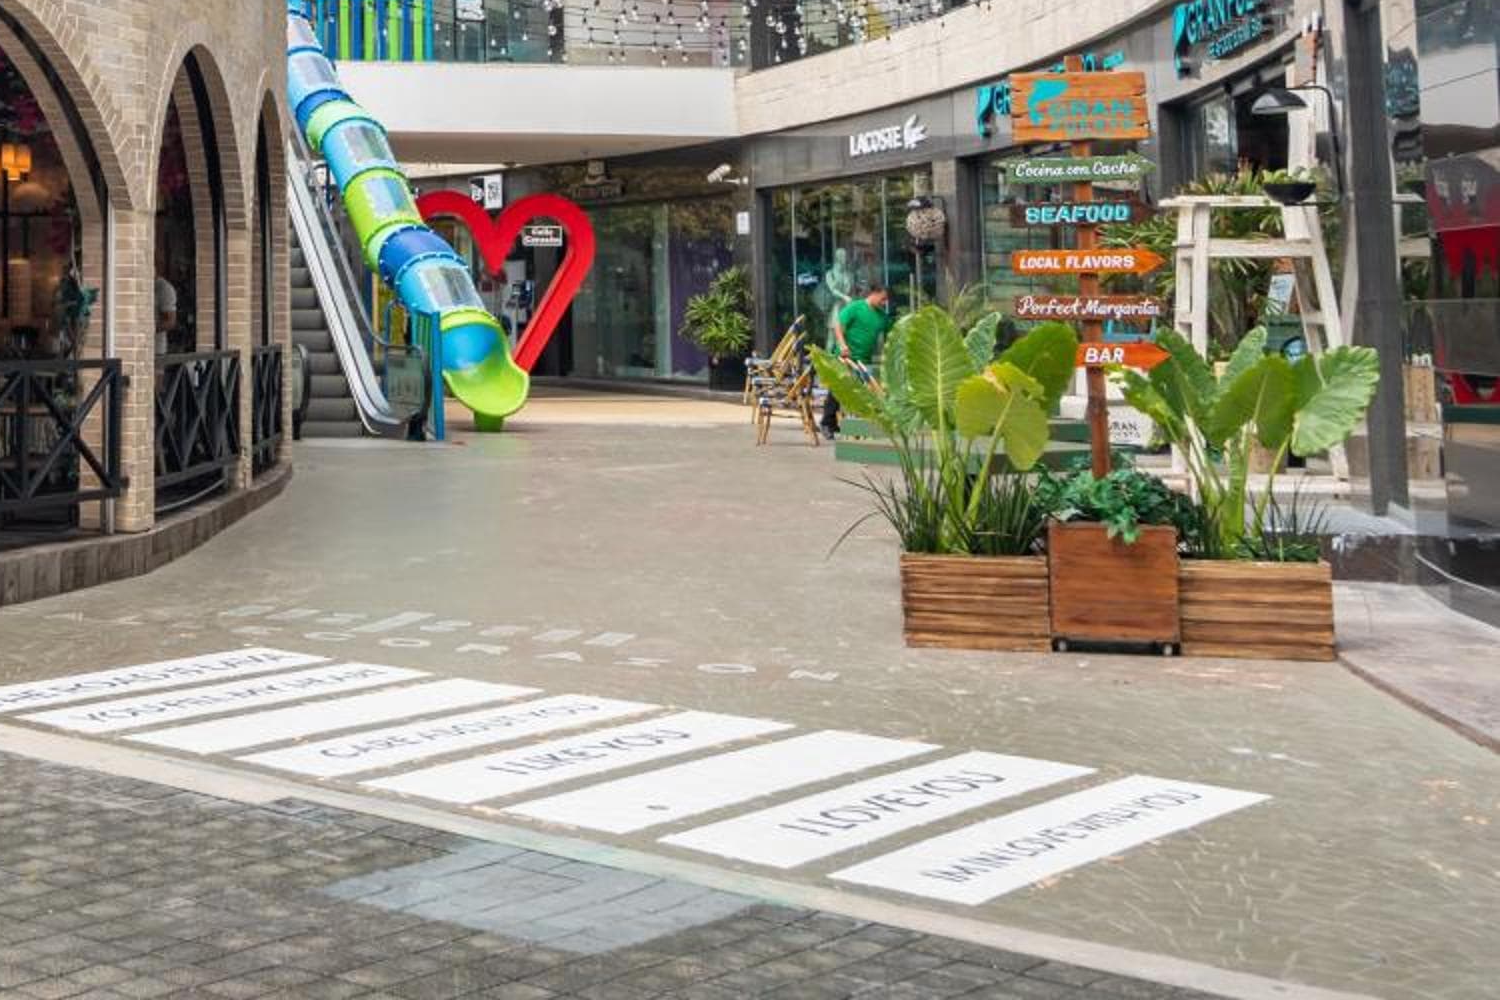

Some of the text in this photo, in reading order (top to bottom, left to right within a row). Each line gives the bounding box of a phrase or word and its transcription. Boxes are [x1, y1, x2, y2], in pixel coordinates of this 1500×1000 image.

[1048, 100, 1133, 119] GRAN
[849, 126, 903, 157] LACOSTE
[1025, 204, 1128, 224] SEAFOOD
[1019, 255, 1135, 269] LOCAL FLAVORS
[1017, 296, 1081, 315] Perfect
[1085, 348, 1125, 363] BAR
[582, 729, 692, 751] YOU
[796, 793, 930, 829] LOVE
[894, 770, 1006, 798] YOU
[996, 826, 1090, 857] LOVE
[1128, 789, 1203, 811] YOU
